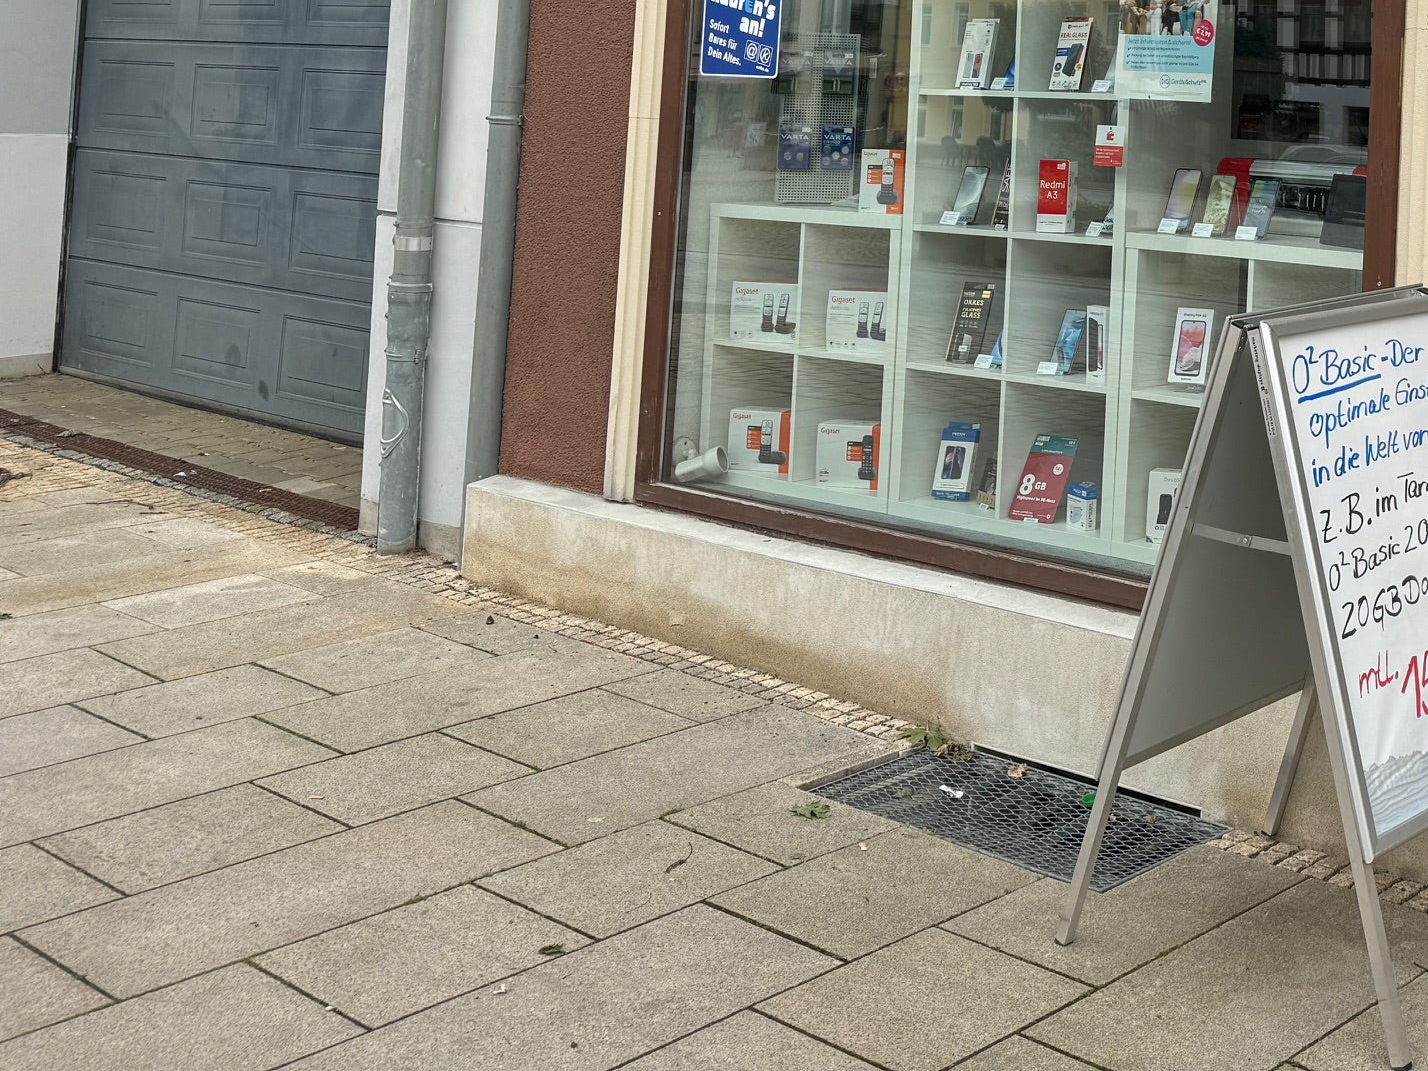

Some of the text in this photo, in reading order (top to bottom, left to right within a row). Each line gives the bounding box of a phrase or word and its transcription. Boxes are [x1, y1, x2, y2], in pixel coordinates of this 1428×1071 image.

[709, 18, 730, 33] Sofort
[739, 16, 766, 38] an!
[708, 32, 738, 51] Bares für
[707, 46, 742, 66] Dein Altes.
[1040, 179, 1066, 189] Redmi
[1046, 191, 1058, 200] A3
[735, 287, 759, 296] Gigaset
[831, 295, 856, 305] Gigaset
[1309, 388, 1391, 448] optimale
[1312, 458, 1330, 487] in
[1334, 442, 1360, 477] die
[1365, 430, 1400, 467] Welt
[1019, 473, 1047, 495] 8 GB
[1375, 487, 1398, 517] im
